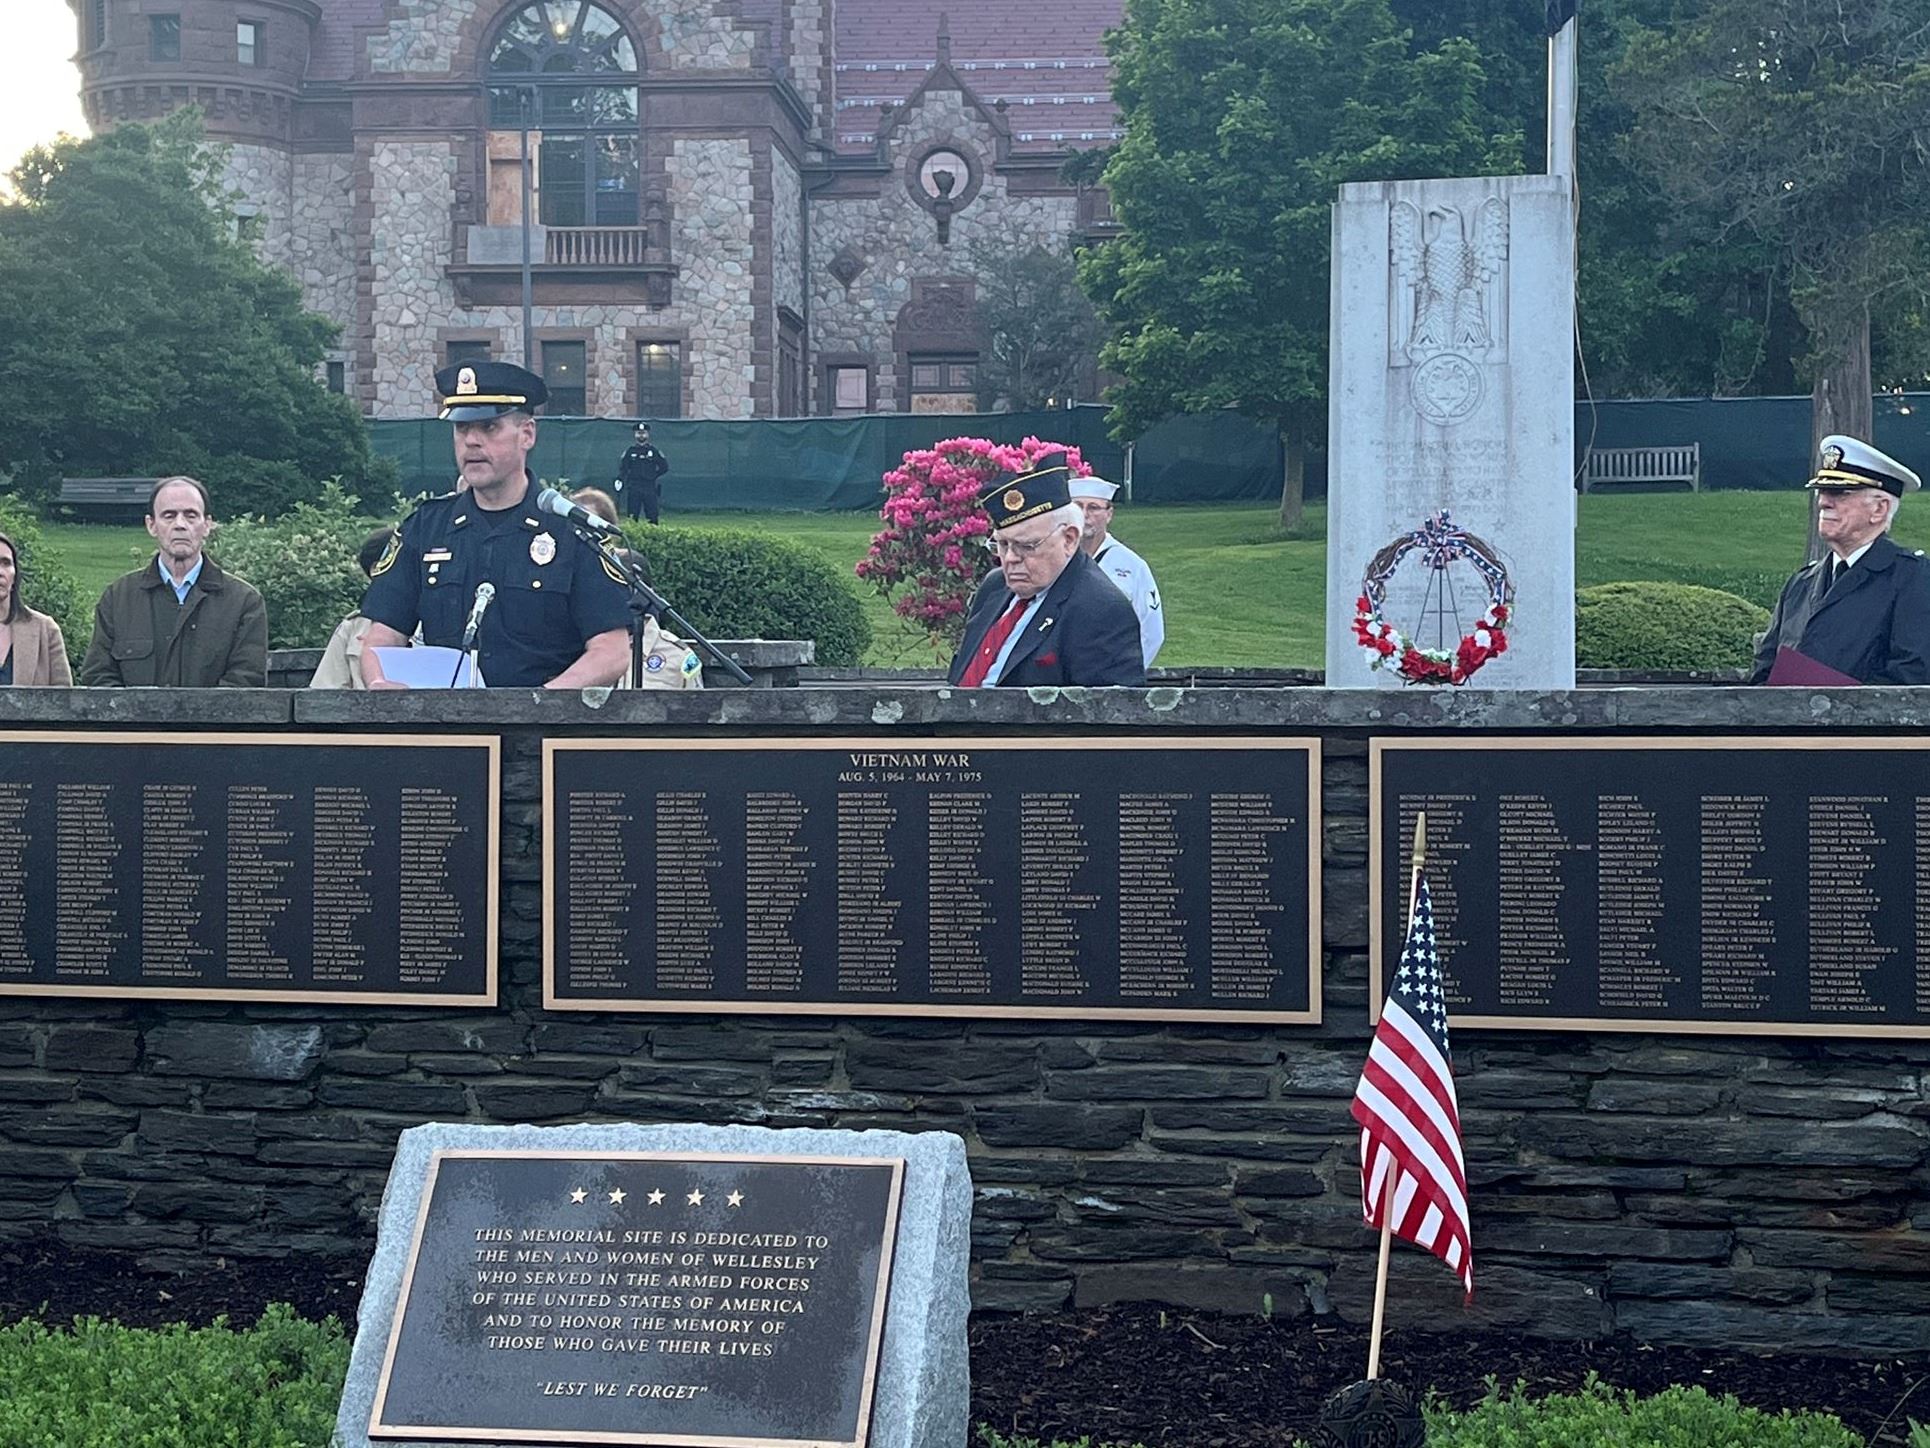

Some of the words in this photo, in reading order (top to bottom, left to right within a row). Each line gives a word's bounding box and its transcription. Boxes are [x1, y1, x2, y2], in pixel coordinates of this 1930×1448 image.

[850, 754, 926, 767] VIETNAM
[933, 754, 970, 767] WAR
[838, 772, 864, 781] AUG.
[868, 772, 877, 782] 5,
[882, 773, 904, 781] 1964
[916, 773, 941, 782] MAY
[945, 773, 954, 782] 7,
[959, 773, 981, 782] 1975
[474, 1229, 513, 1242] THIS
[520, 1230, 615, 1243] MEMORIAL
[623, 1231, 663, 1244] SITE
[670, 1233, 687, 1244] IS
[694, 1234, 797, 1248] DEDICATED
[806, 1237, 829, 1248] TO
[475, 1250, 508, 1262] THE
[516, 1251, 552, 1263] MEN
[560, 1252, 598, 1263] AND
[607, 1252, 674, 1265] WOMEN
[681, 1254, 705, 1266] OF
[712, 1254, 820, 1269] WELLESLEY
[477, 1271, 517, 1284] WHO
[524, 1272, 592, 1285] SERVED
[600, 1273, 619, 1285] IN
[627, 1274, 661, 1286] THE
[668, 1275, 732, 1289] ARMED
[740, 1276, 810, 1290] FORCES
[473, 1293, 496, 1305] OF
[502, 1293, 537, 1305] THE
[544, 1294, 612, 1307] UNITED
[618, 1295, 682, 1308] STATES
[690, 1297, 714, 1309] OF
[720, 1297, 804, 1312] AMERICA
[484, 1314, 522, 1327] AND
[531, 1315, 552, 1328] TO
[560, 1316, 622, 1329] HONOR
[631, 1318, 665, 1330] THE
[673, 1318, 753, 1333] MEMORY
[761, 1322, 785, 1334] OF
[488, 1336, 545, 1349] THOSE
[553, 1338, 594, 1350] WHO
[602, 1339, 650, 1352] GAVE
[657, 1340, 710, 1353] THEIR
[719, 1342, 773, 1356] LIVES
[537, 1381, 588, 1395] "LEST
[594, 1383, 619, 1396] WE
[626, 1384, 708, 1399] FORGET"
